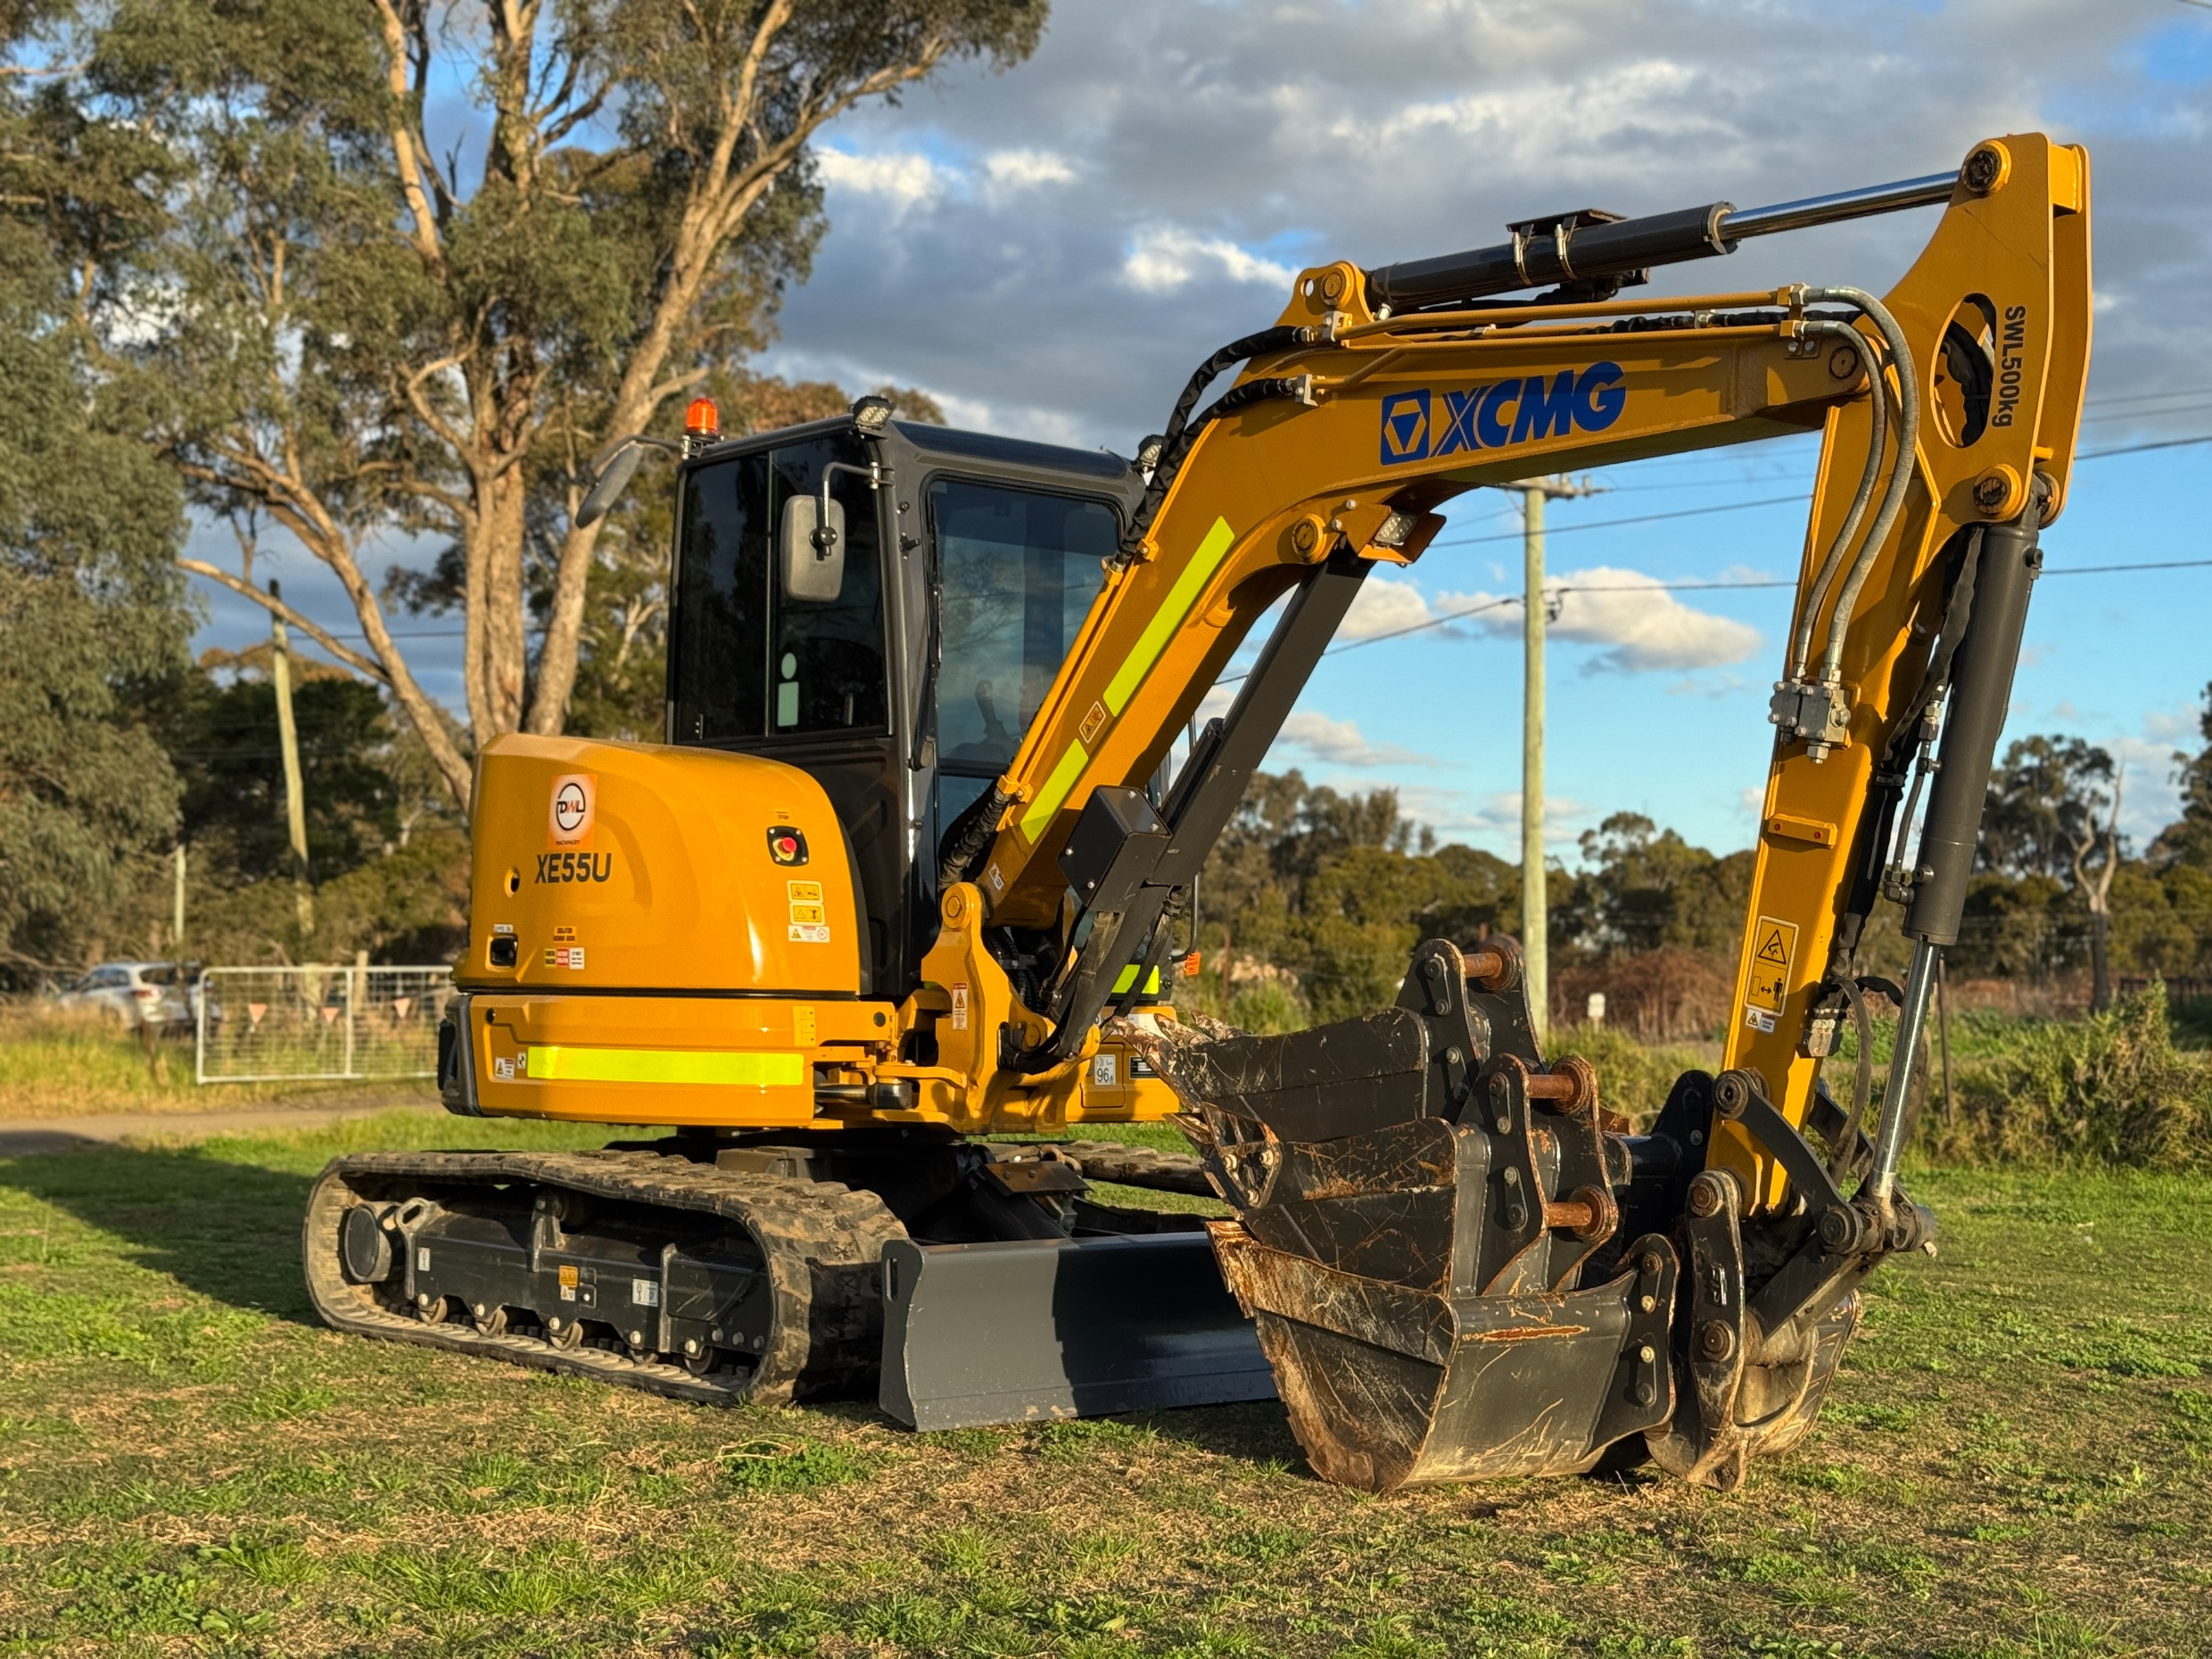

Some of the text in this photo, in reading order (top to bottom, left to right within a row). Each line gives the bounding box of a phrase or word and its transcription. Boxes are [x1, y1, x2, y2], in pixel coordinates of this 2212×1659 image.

[1992, 305, 2026, 427] SWL500kg
[1429, 361, 1627, 458] XCMG
[534, 853, 612, 884] XE55U
[1097, 1068, 1110, 1083] 96
